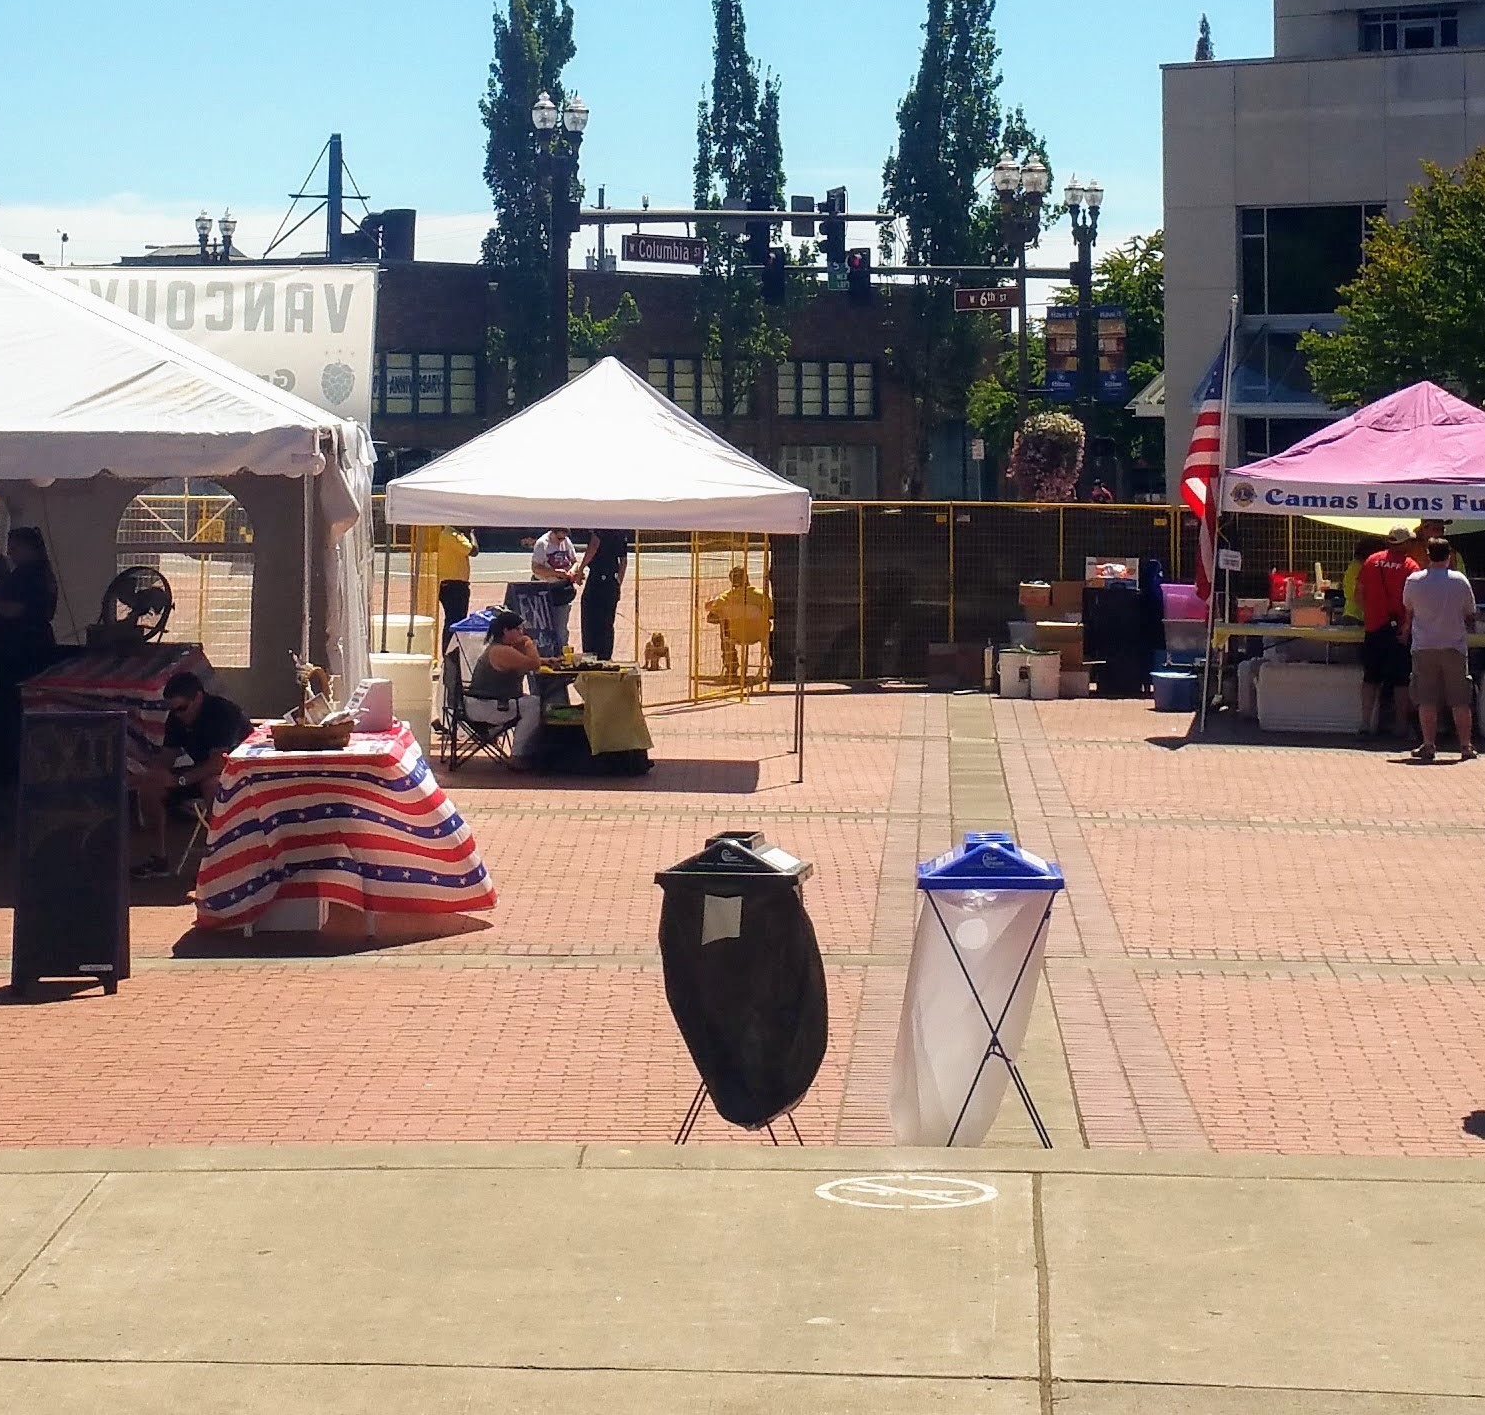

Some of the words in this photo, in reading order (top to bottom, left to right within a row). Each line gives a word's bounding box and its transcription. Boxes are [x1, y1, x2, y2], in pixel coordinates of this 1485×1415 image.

[638, 239, 690, 261] Columbia
[979, 291, 996, 307] 6th
[388, 374, 443, 394] ANNIVRSARY
[1265, 488, 1359, 510] Camas
[1367, 491, 1444, 511] Lions
[1374, 560, 1403, 570] STAFF
[517, 591, 553, 630] EXIT
